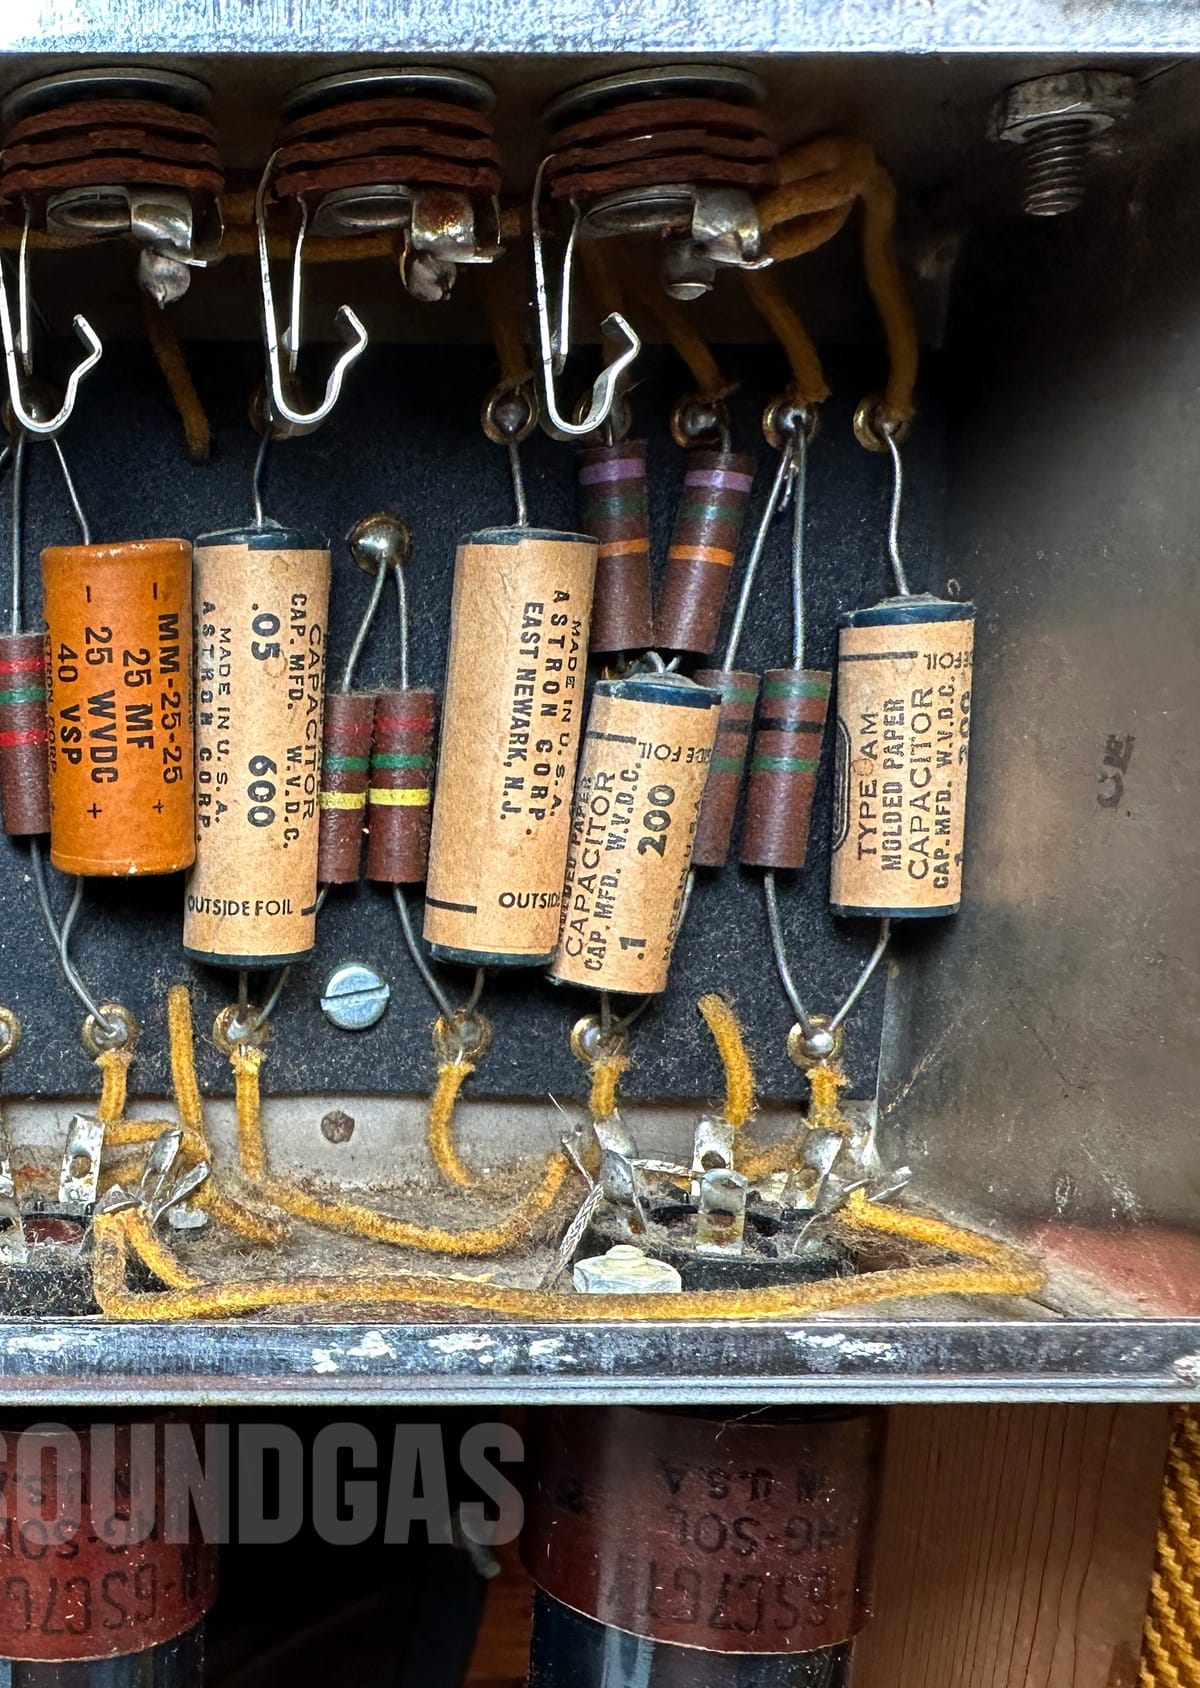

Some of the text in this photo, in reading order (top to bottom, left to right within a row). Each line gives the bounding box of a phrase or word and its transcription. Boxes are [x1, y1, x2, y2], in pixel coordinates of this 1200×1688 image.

[219, 628, 231, 695] MADE
[519, 602, 544, 659] EAST
[540, 589, 569, 717] ASTRON
[565, 620, 581, 689] MADE
[59, 643, 82, 764] 40 VSP
[85, 626, 118, 784] 25 WVDC
[123, 648, 154, 749] 25 MF
[157, 614, 183, 784] MM-25-25
[217, 708, 230, 729] IN
[303, 623, 321, 820] CAPACITOR
[562, 700, 574, 722] IN
[637, 742, 682, 754] FOIL
[247, 755, 277, 827] 600
[637, 784, 675, 857] 200
[858, 712, 878, 859] TYPE AM
[881, 699, 904, 870] MOLDED PAPER
[908, 688, 932, 879] CAPACITOR
[187, 896, 293, 916] OUTSIDE FOIL
[564, 772, 615, 957] CAPACITOR
